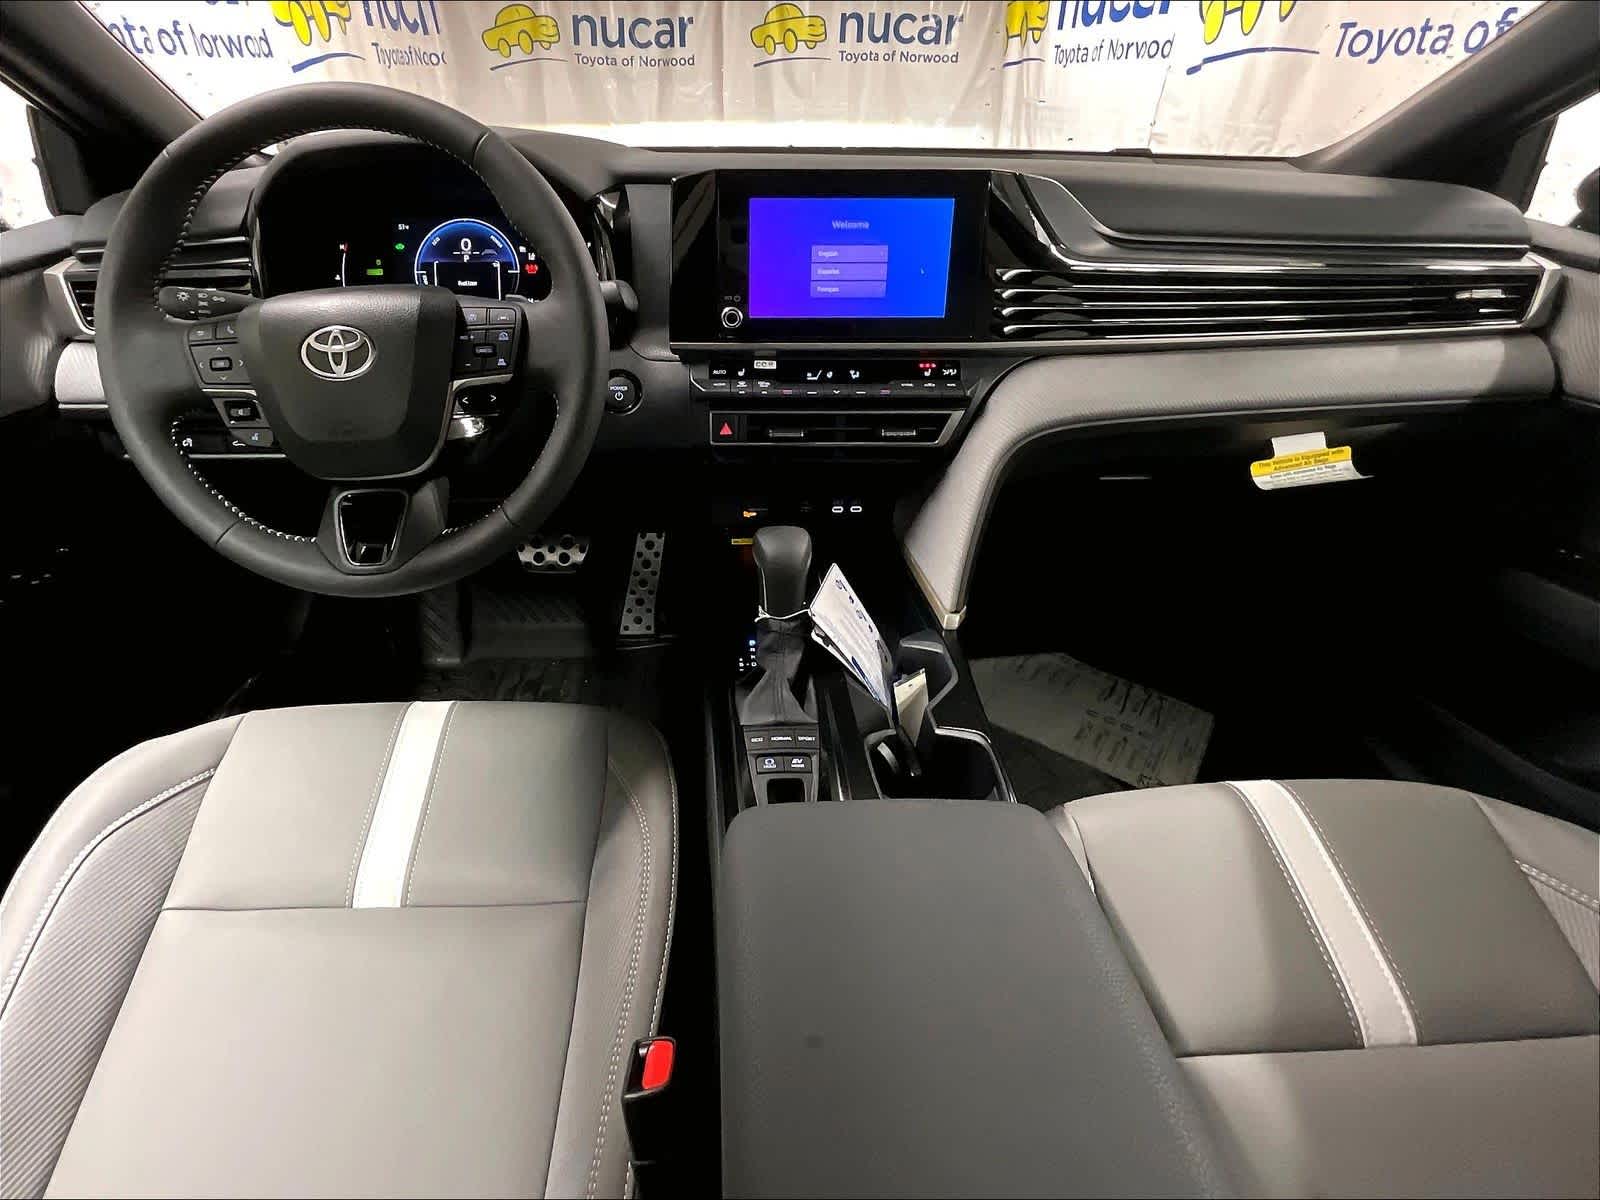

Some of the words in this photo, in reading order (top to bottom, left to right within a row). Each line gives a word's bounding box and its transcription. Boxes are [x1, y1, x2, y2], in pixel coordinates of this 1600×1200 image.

[840, 12, 963, 45] nucar
[1058, 1, 1170, 30] nuc
[108, 15, 154, 54] ota
[157, 20, 188, 55] of
[572, 15, 693, 49] nucar
[1336, 18, 1454, 64] Toyota
[1463, 7, 1518, 53] of
[574, 53, 617, 67] Toyota
[622, 56, 634, 66] of
[639, 56, 695, 67] Norwood
[838, 50, 879, 64] Toyota
[883, 50, 896, 62] of
[900, 51, 959, 63] Norwood
[1054, 44, 1088, 68] Toyota
[1092, 38, 1104, 62] of
[832, 220, 870, 229] Welcome
[461, 238, 472, 251] 0
